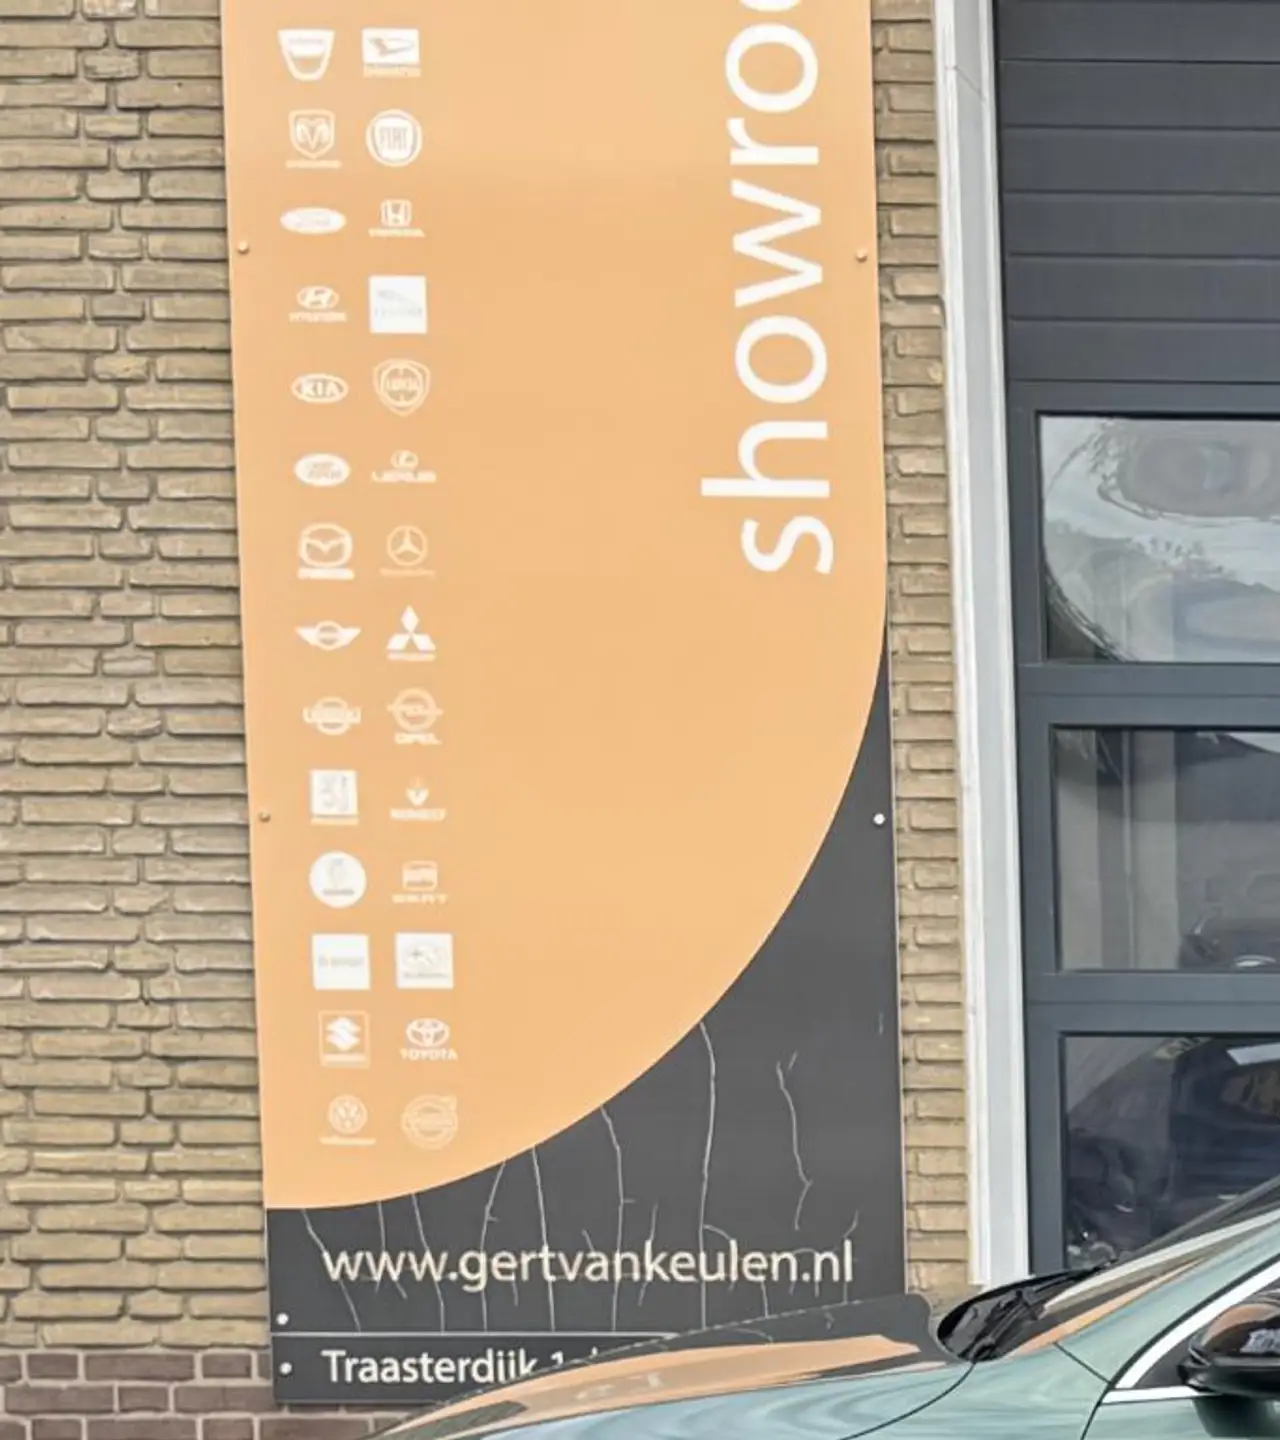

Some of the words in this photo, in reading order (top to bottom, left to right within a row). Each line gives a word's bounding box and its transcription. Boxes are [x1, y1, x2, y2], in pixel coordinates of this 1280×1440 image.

[701, 0, 834, 574] showro
[300, 380, 341, 397] KIA
[399, 1047, 458, 1061] TOYOTA
[320, 1240, 854, 1292] www.gertvankeulen.nl
[320, 1347, 539, 1384] Traasterdijk
